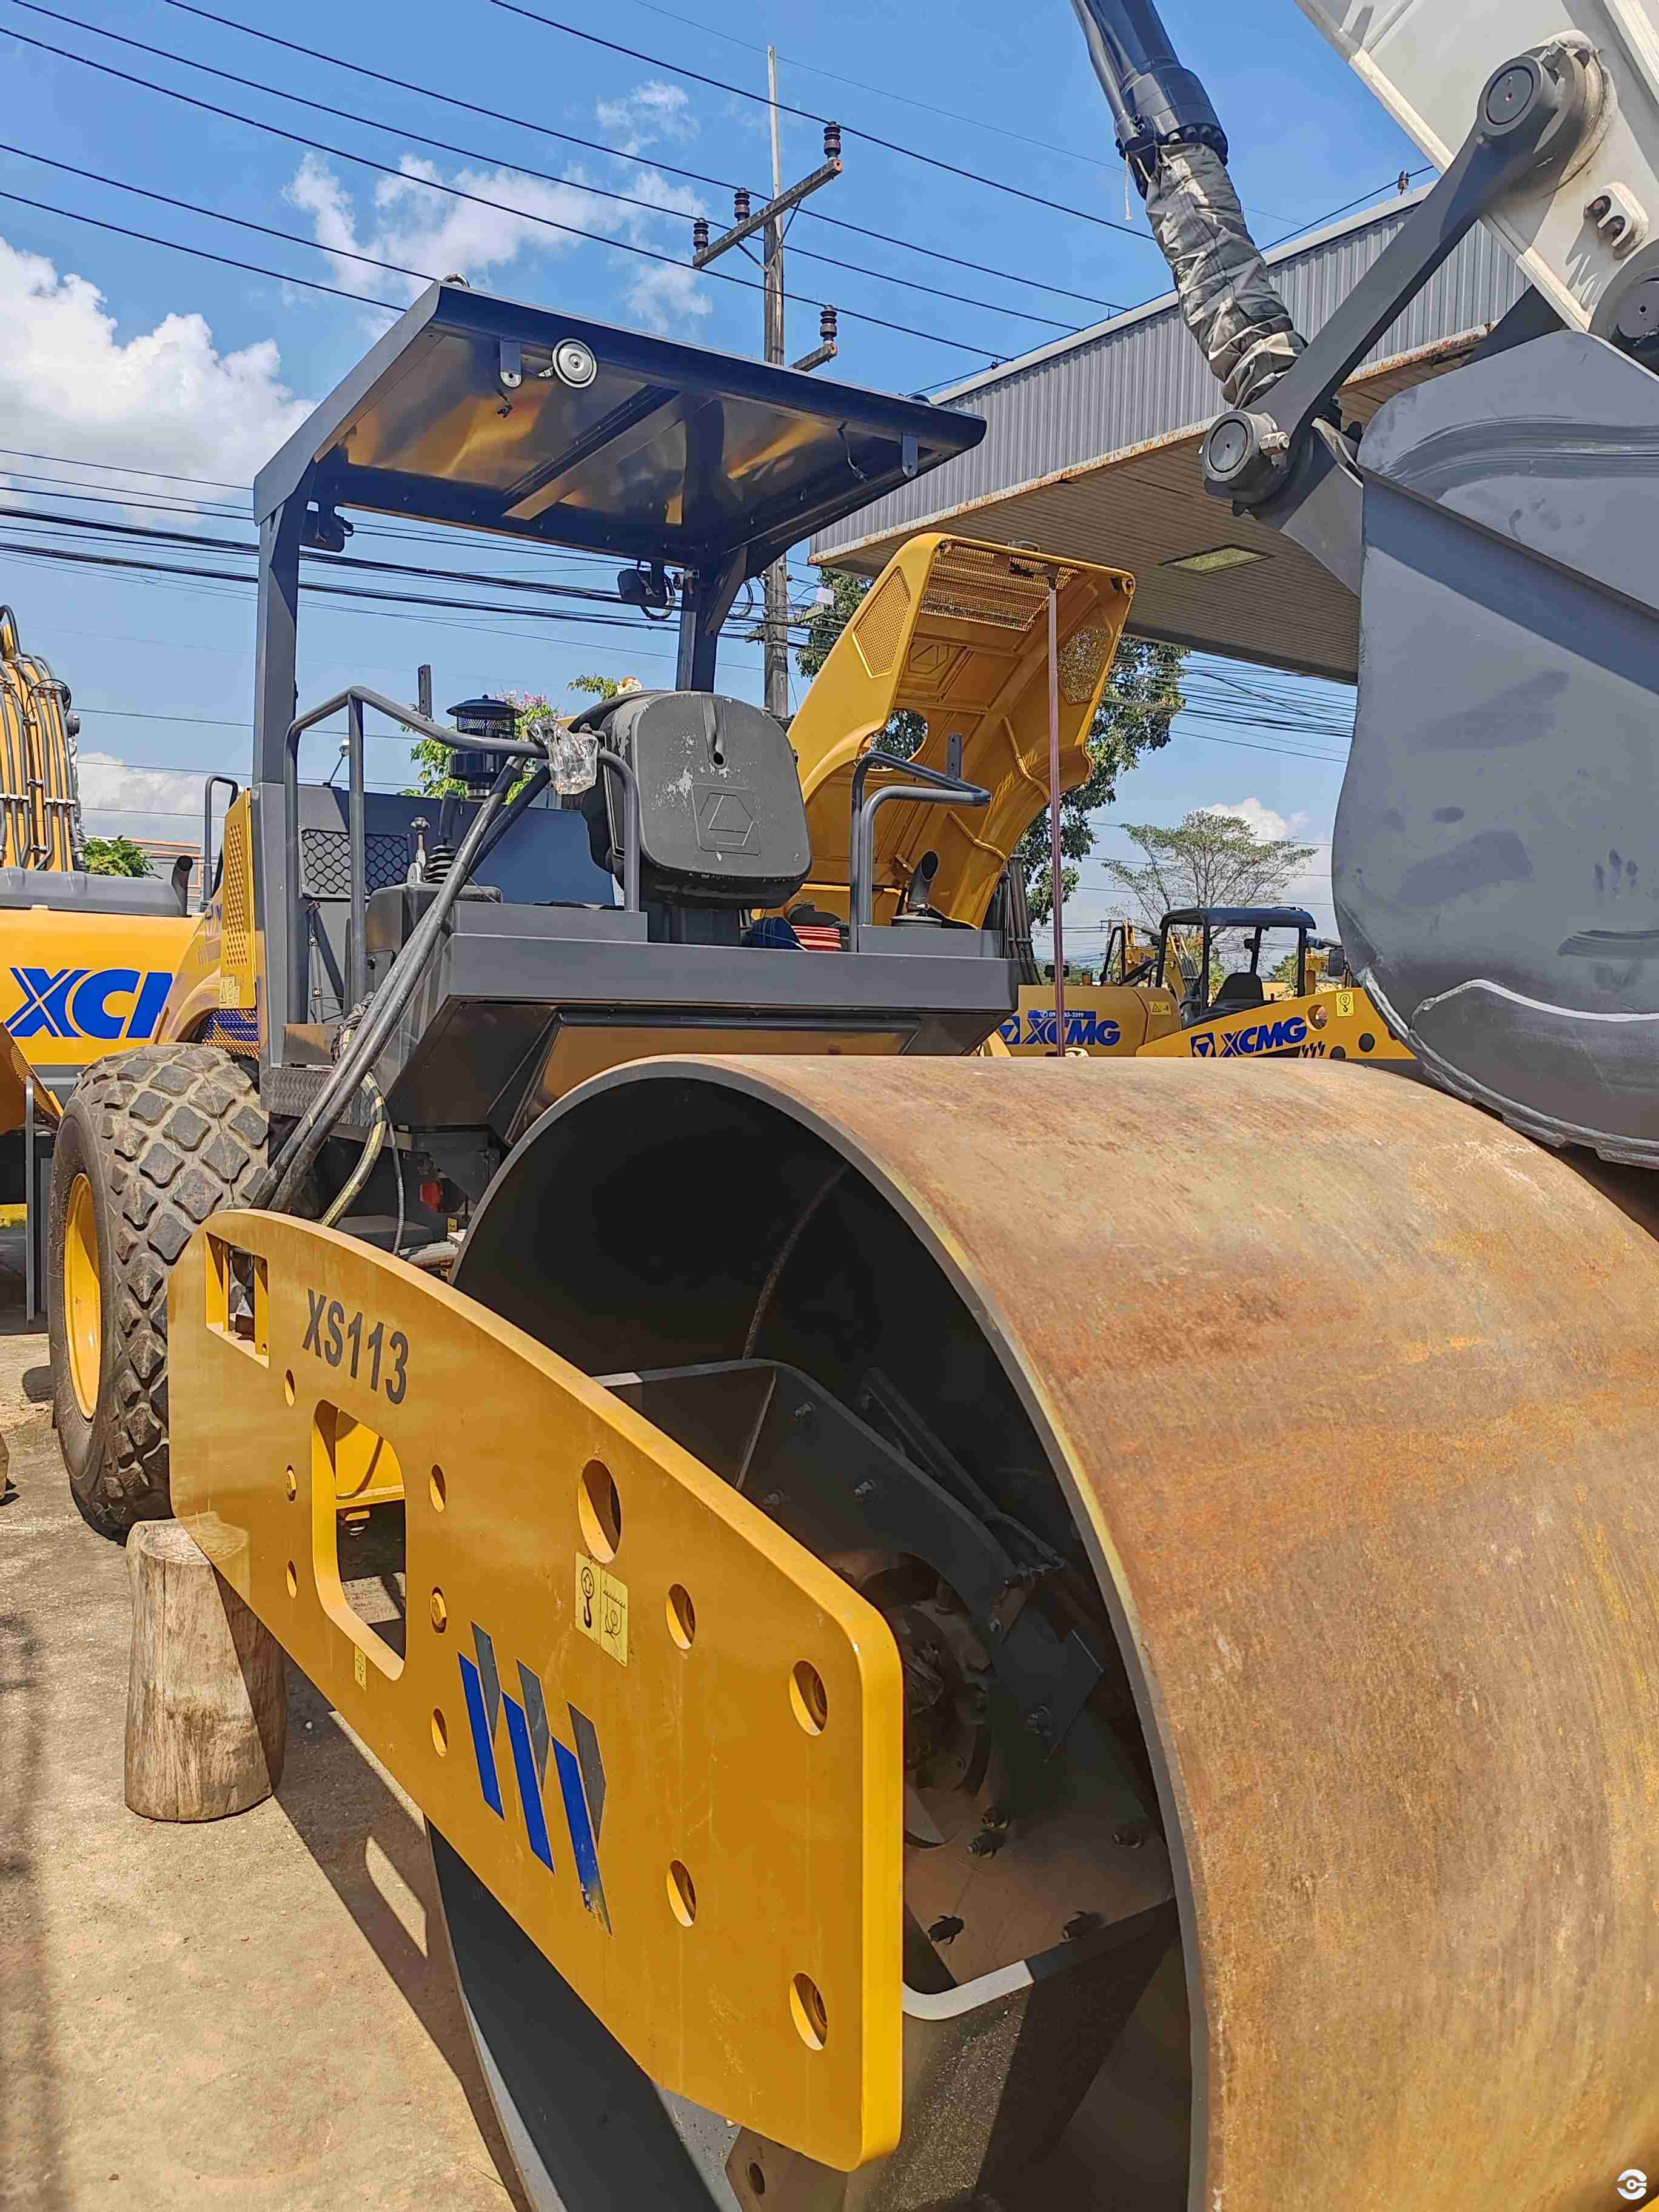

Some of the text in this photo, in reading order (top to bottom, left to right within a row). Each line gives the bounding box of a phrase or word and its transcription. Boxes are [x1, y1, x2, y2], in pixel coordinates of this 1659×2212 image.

[1021, 1019, 1121, 1047] XCMG
[1219, 1016, 1307, 1057] XCMG
[302, 1287, 409, 1405] XS113
